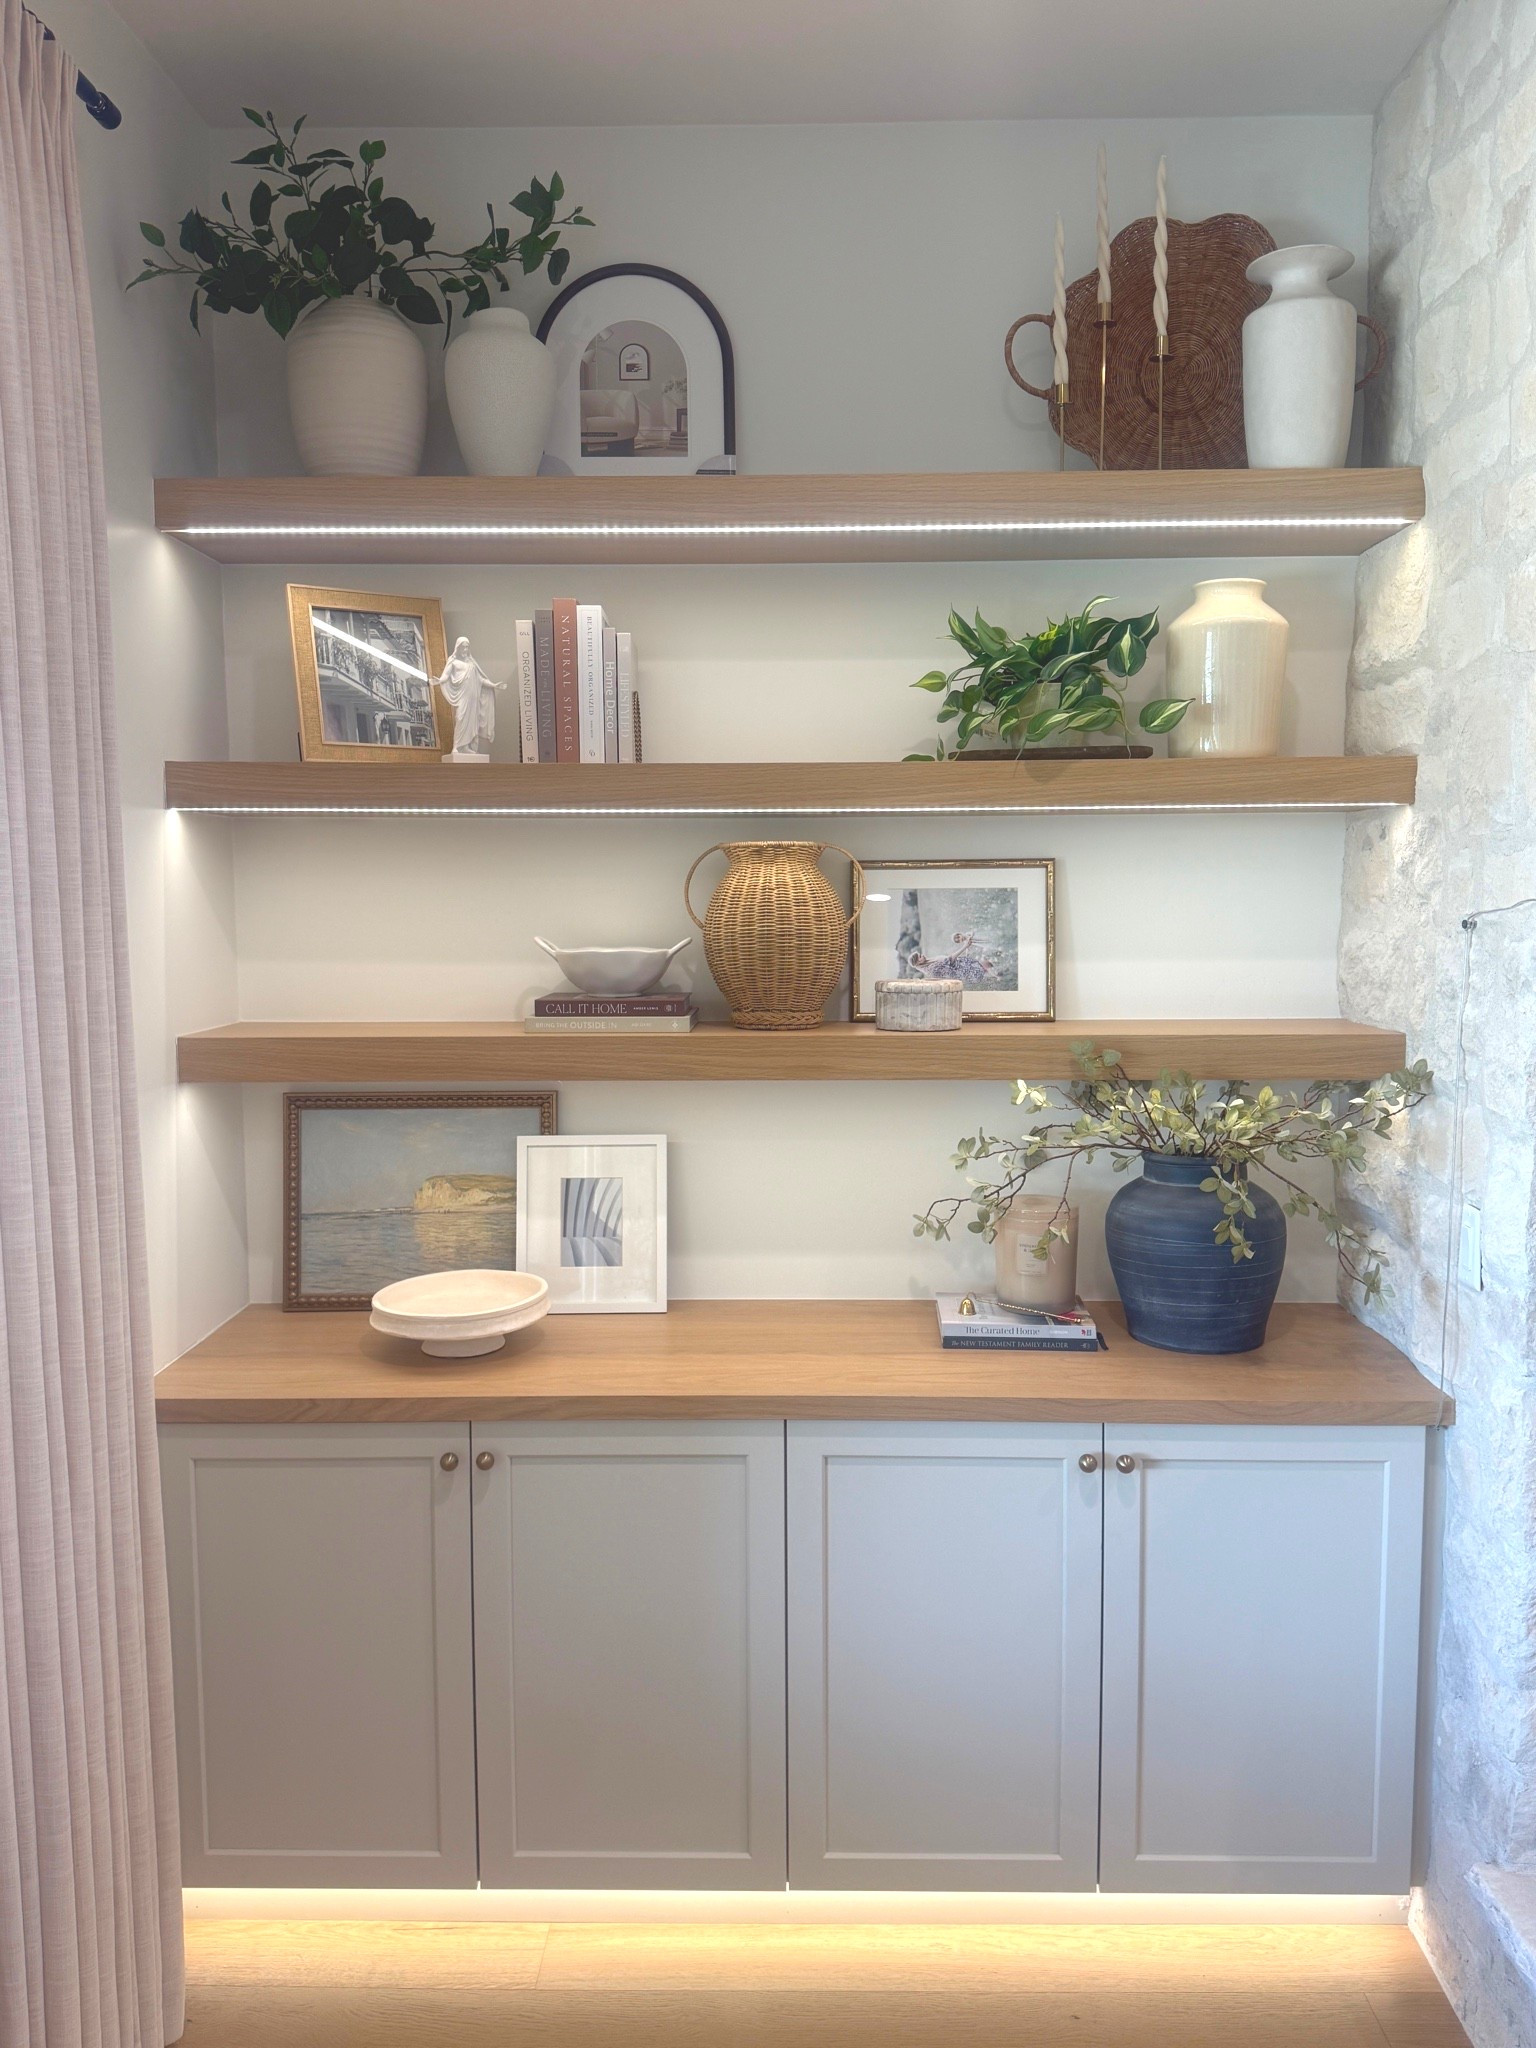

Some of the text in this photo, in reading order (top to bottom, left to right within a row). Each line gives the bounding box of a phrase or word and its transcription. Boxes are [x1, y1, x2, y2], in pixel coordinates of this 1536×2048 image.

[539, 637, 550, 676] MADE
[521, 651, 534, 742] ORGANIZED LIVING
[561, 615, 573, 752] NATURAL SPACES
[605, 661, 616, 734] Home Decor
[620, 672, 630, 738] LIFESTYLED
[540, 690, 552, 738] LIVING
[545, 1003, 576, 1014] CALL
[578, 1003, 589, 1014] IT
[591, 1003, 627, 1014] HOME
[569, 1021, 606, 1029] OUTSIDE
[965, 1326, 980, 1334] The
[980, 1326, 1015, 1335] Curated
[1016, 1326, 1040, 1335] Home
